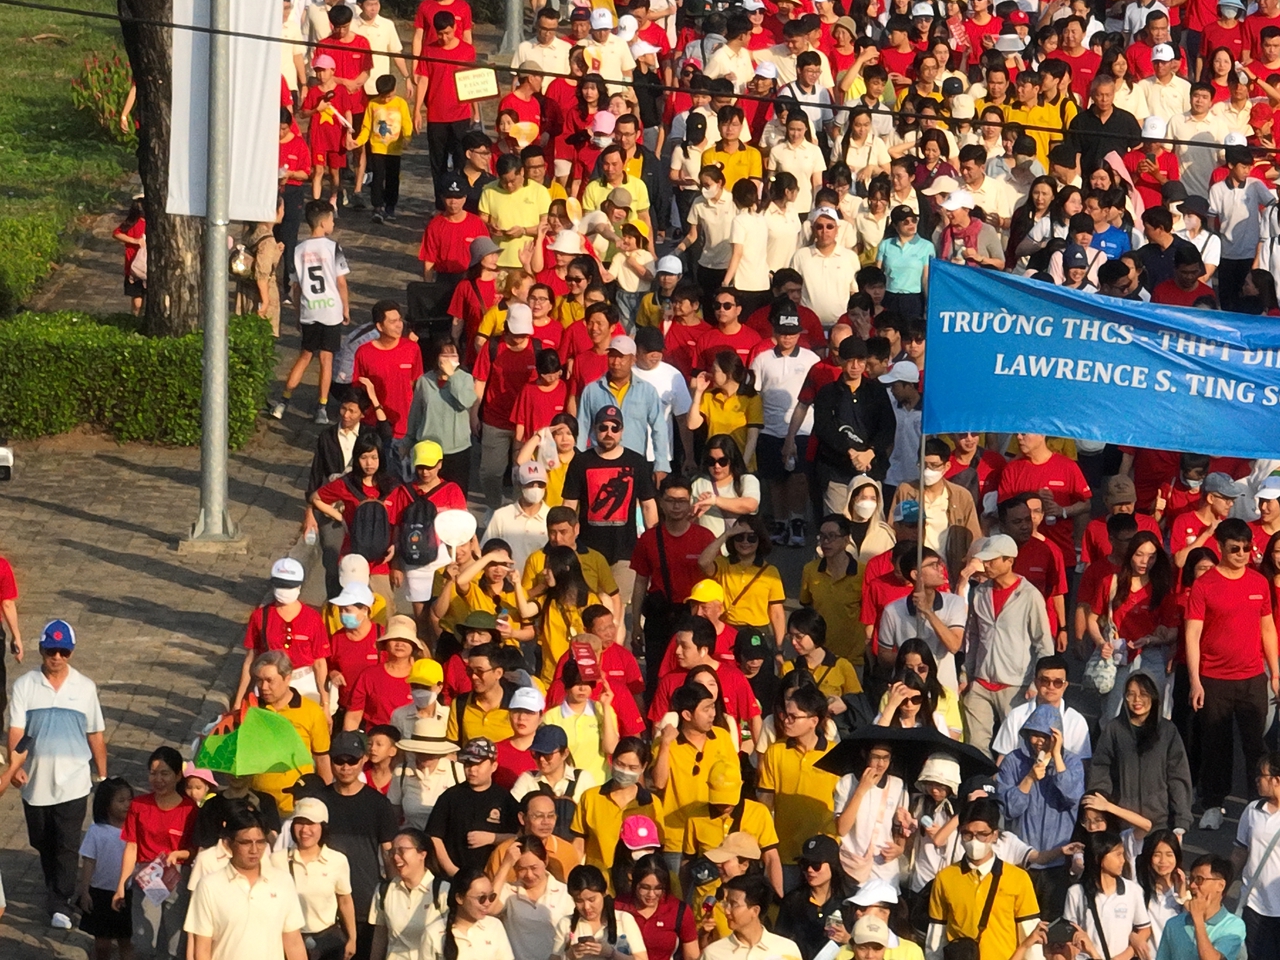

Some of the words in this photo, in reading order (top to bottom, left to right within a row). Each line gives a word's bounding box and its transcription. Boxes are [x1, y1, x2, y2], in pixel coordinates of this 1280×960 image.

[308, 265, 327, 294] 5
[939, 308, 1053, 337] TRƯỜNG
[1061, 318, 1134, 345] THCS
[993, 353, 1149, 389] LAWRENCE
[1154, 369, 1178, 392] S.
[1186, 372, 1256, 404] TING
[528, 465, 539, 474] M
